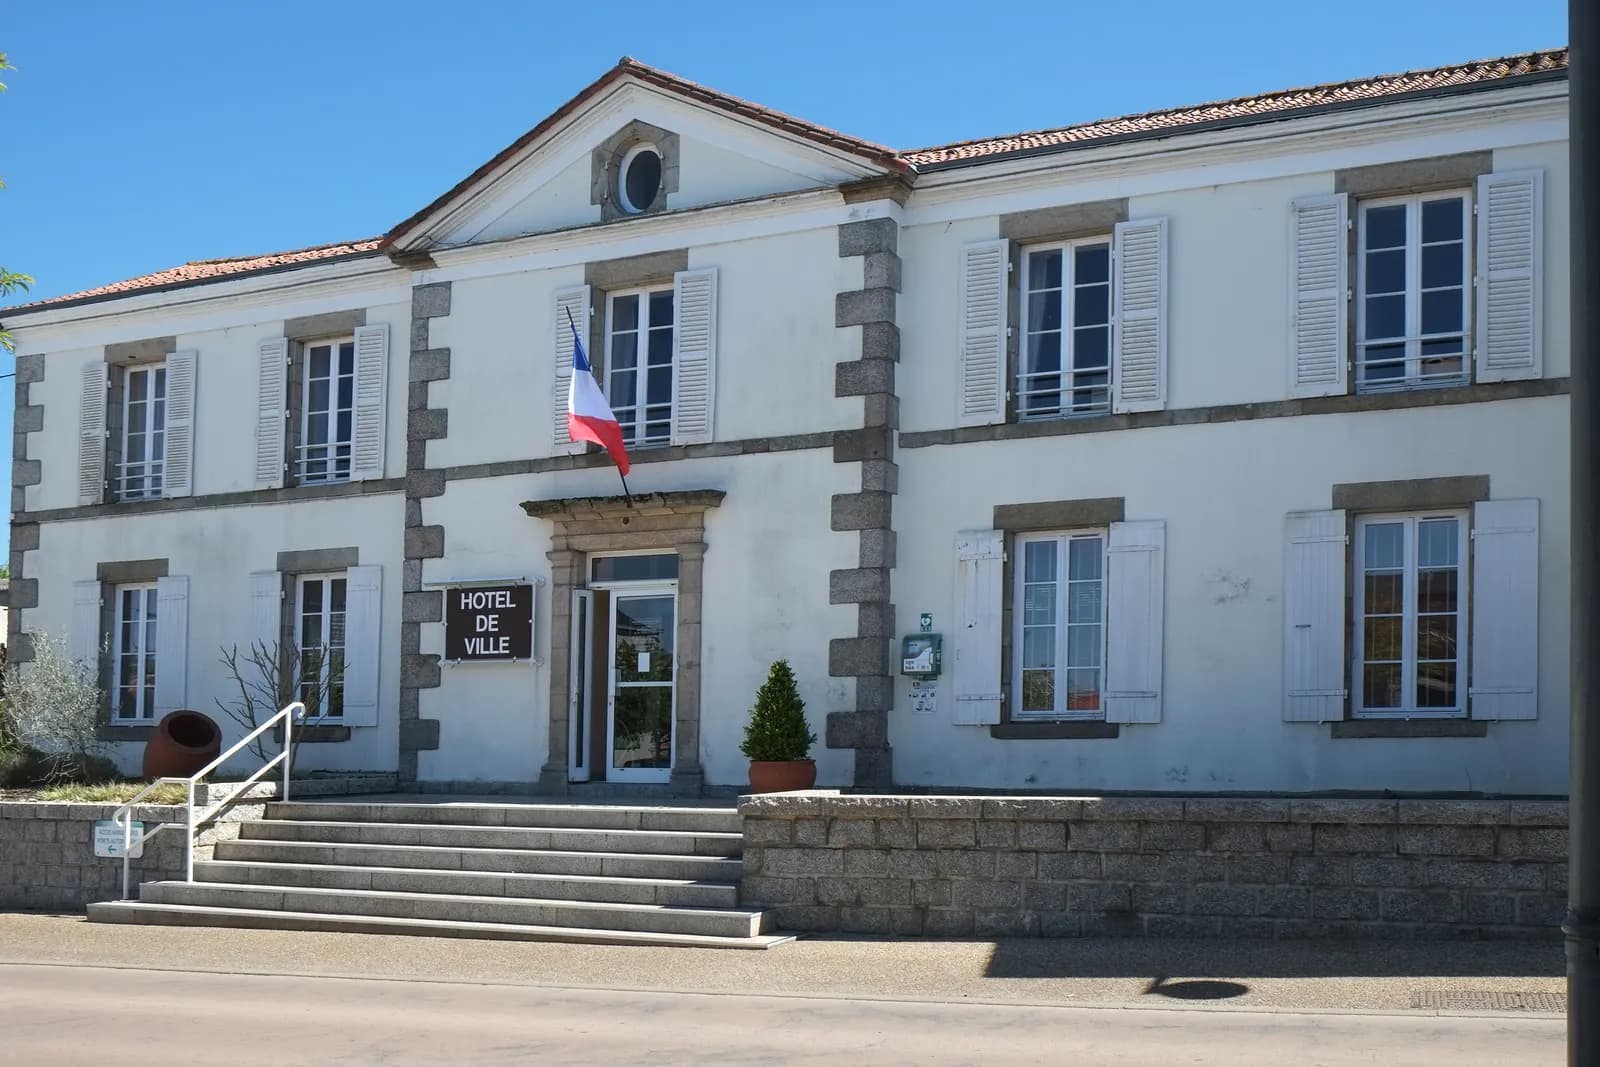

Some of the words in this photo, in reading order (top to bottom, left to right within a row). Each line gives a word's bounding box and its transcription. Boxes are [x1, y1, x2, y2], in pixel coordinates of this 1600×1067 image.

[461, 591, 516, 609] HOTEL
[476, 614, 499, 632] DE
[464, 637, 510, 655] VILLE
